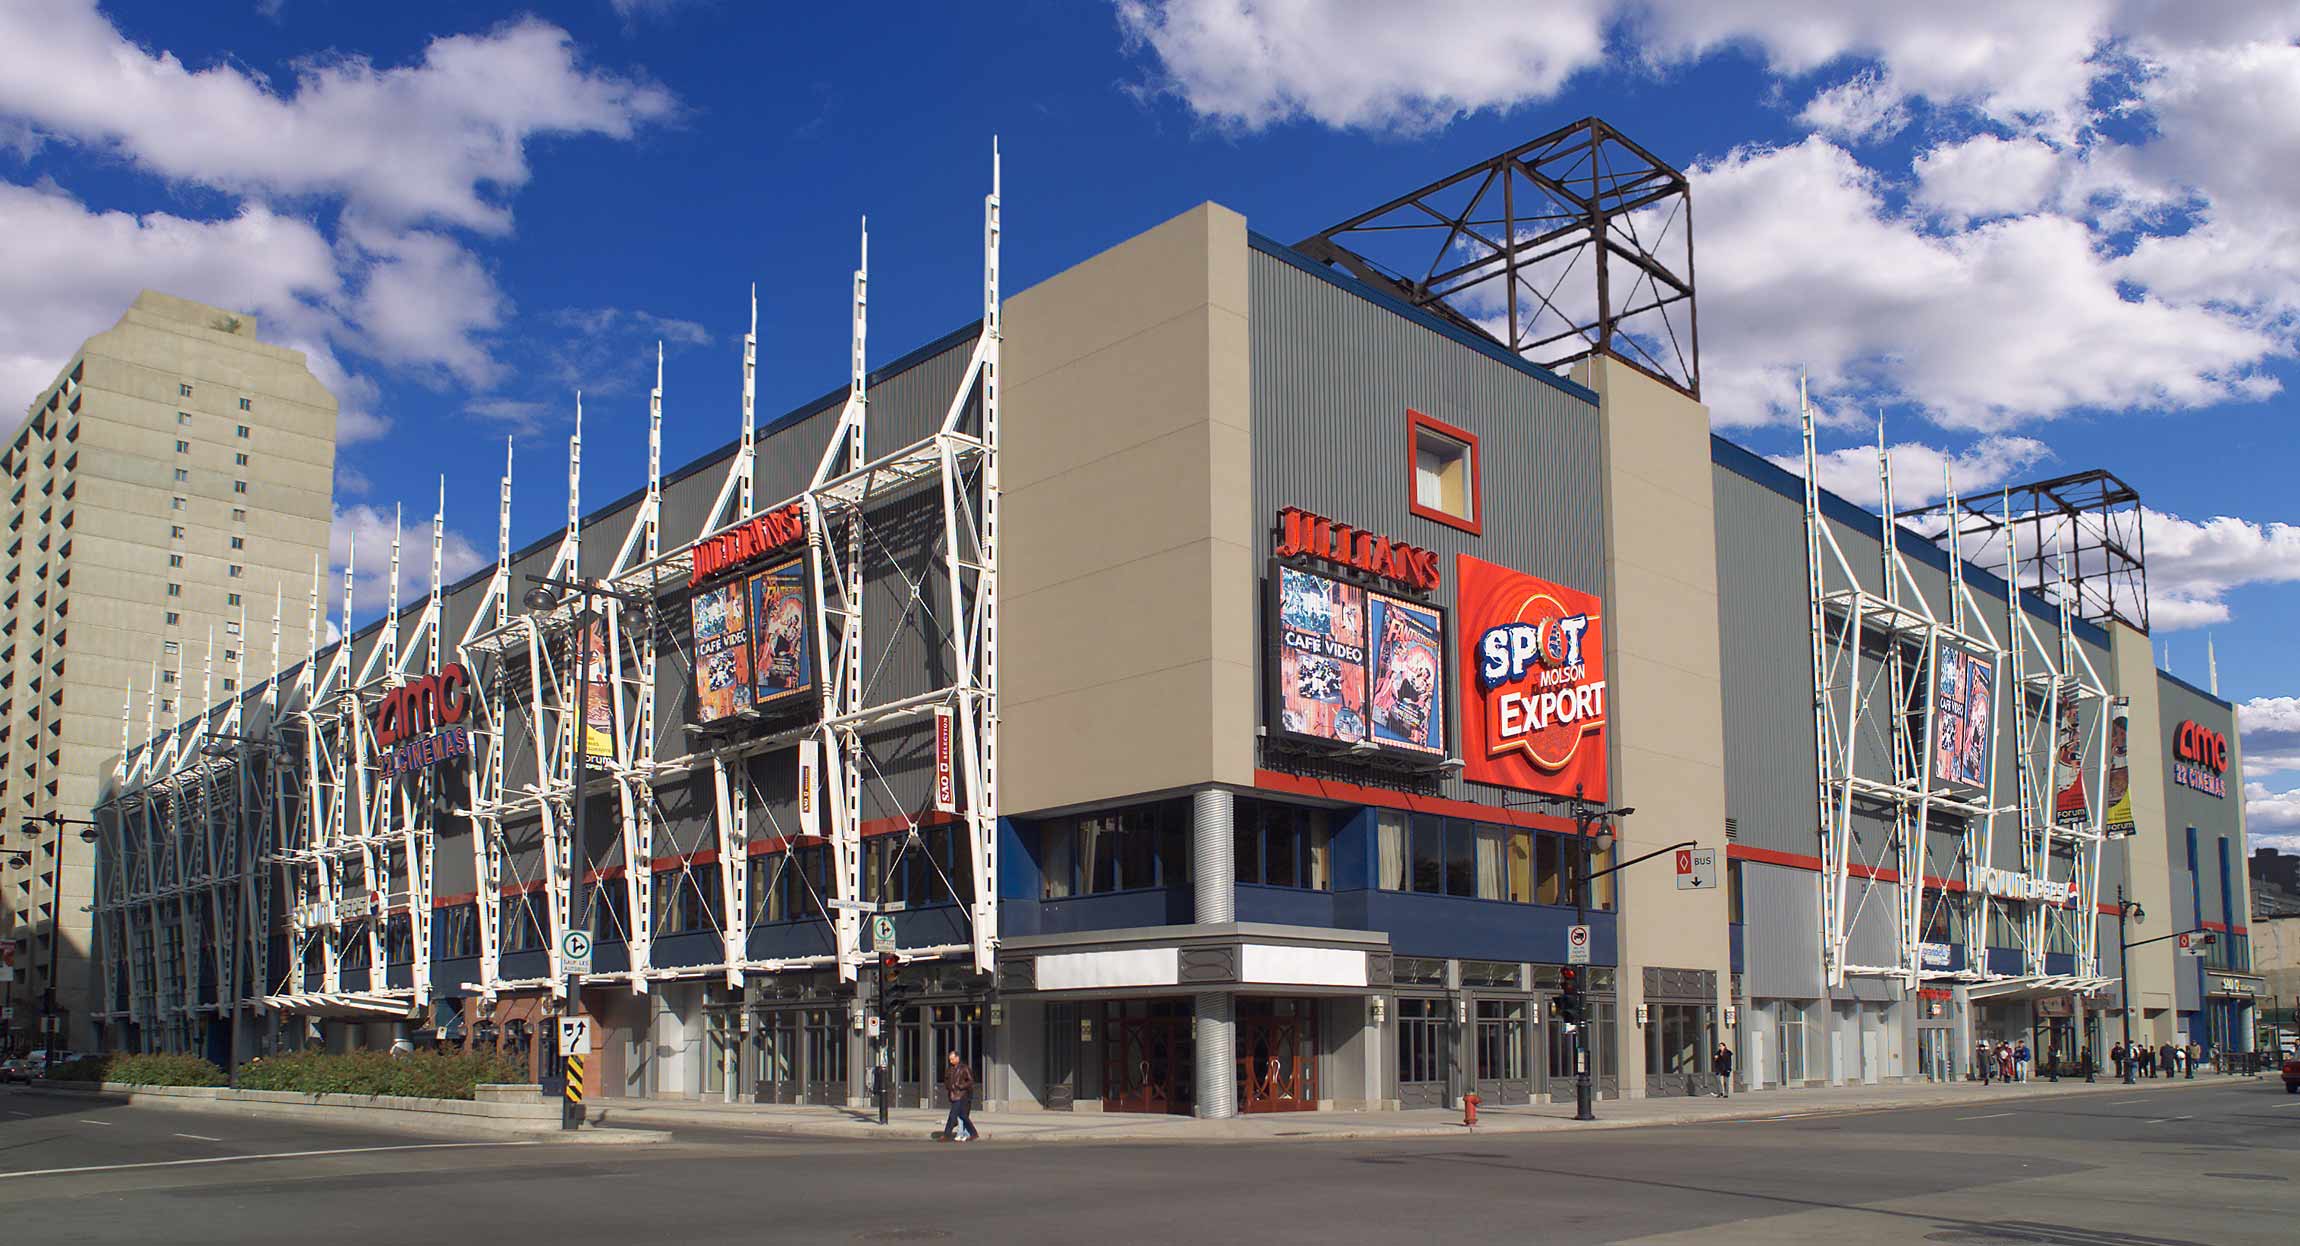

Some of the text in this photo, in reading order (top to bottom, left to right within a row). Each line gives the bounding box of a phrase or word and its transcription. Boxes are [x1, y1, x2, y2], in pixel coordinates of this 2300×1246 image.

[1276, 506, 1440, 591] JILLIANS
[1541, 663, 1585, 688] MOLSON
[1500, 680, 1606, 738] EXPORT
[399, 727, 467, 773] CINEMAS
[2188, 767, 2226, 799] CINEMAS
[1694, 856, 1712, 866] BUS
